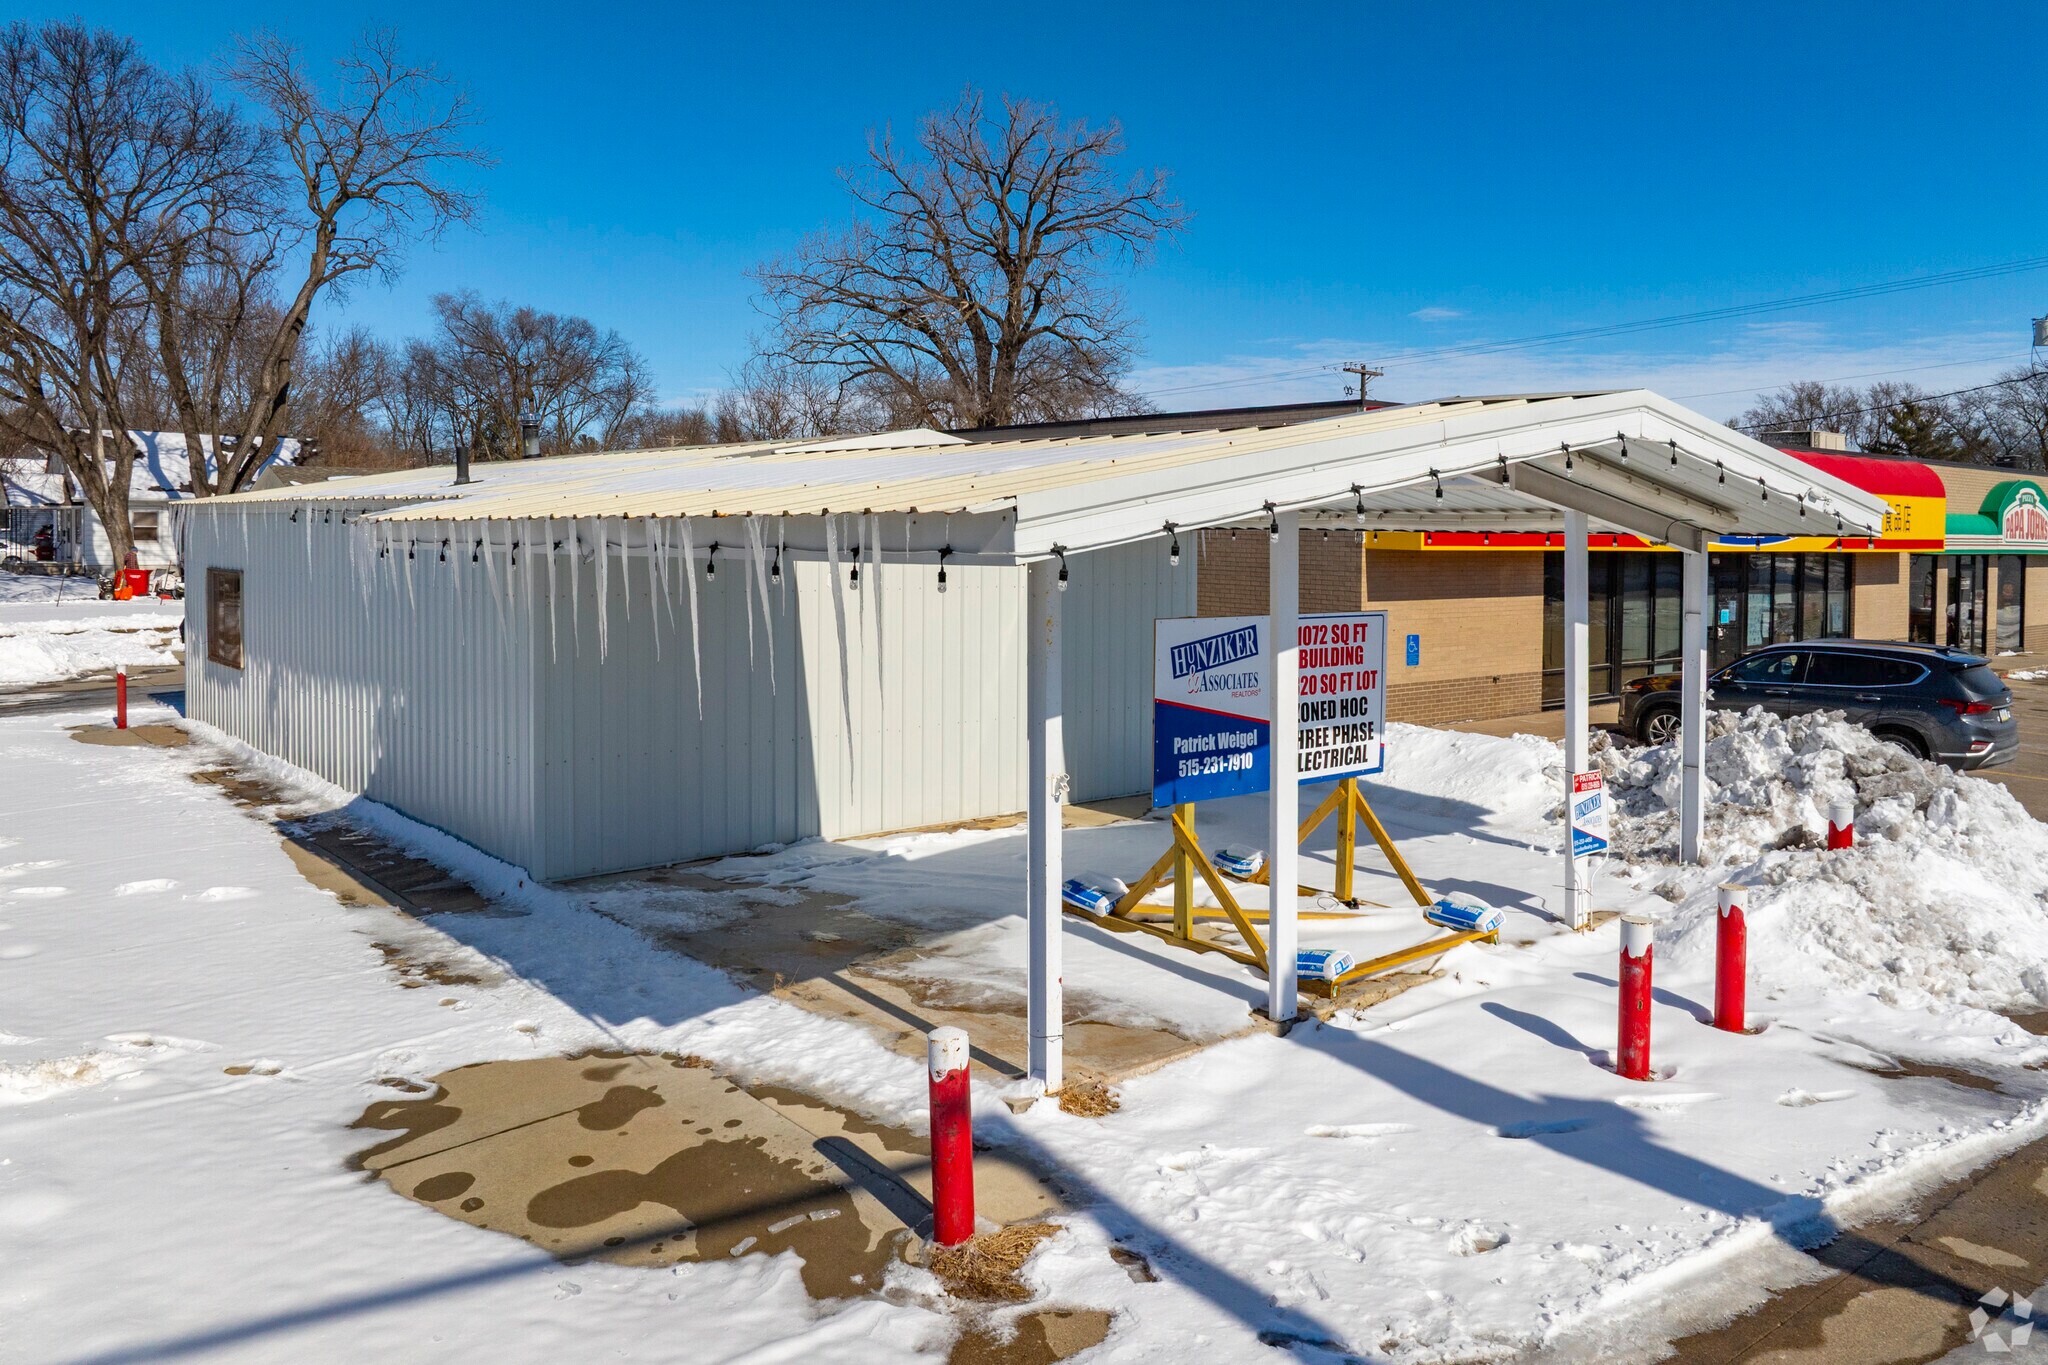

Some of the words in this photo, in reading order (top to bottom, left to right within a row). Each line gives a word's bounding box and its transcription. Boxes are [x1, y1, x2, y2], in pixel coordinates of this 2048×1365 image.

[2005, 508, 2025, 539] PAPA
[1298, 624, 1328, 646] 1072
[1331, 623, 1350, 645] SQ
[1353, 623, 1368, 643] FT
[1173, 628, 1257, 676] HUNZIKER
[1298, 645, 1364, 669] BUILDING
[1199, 671, 1259, 692] ASSOCIATES
[1298, 675, 1317, 696] 20
[1320, 673, 1337, 695] SQ
[1340, 671, 1354, 692] FT
[1356, 670, 1378, 691] LOT
[1298, 699, 1337, 723] ONED
[1340, 696, 1368, 719] HOC
[1173, 734, 1216, 755] Patrick
[1217, 729, 1258, 749] Weigel
[1298, 726, 1329, 750] HREE
[1332, 721, 1374, 746] PHASE
[1178, 752, 1253, 777] 515-231-7910
[1298, 744, 1368, 773] LECTRICAL
